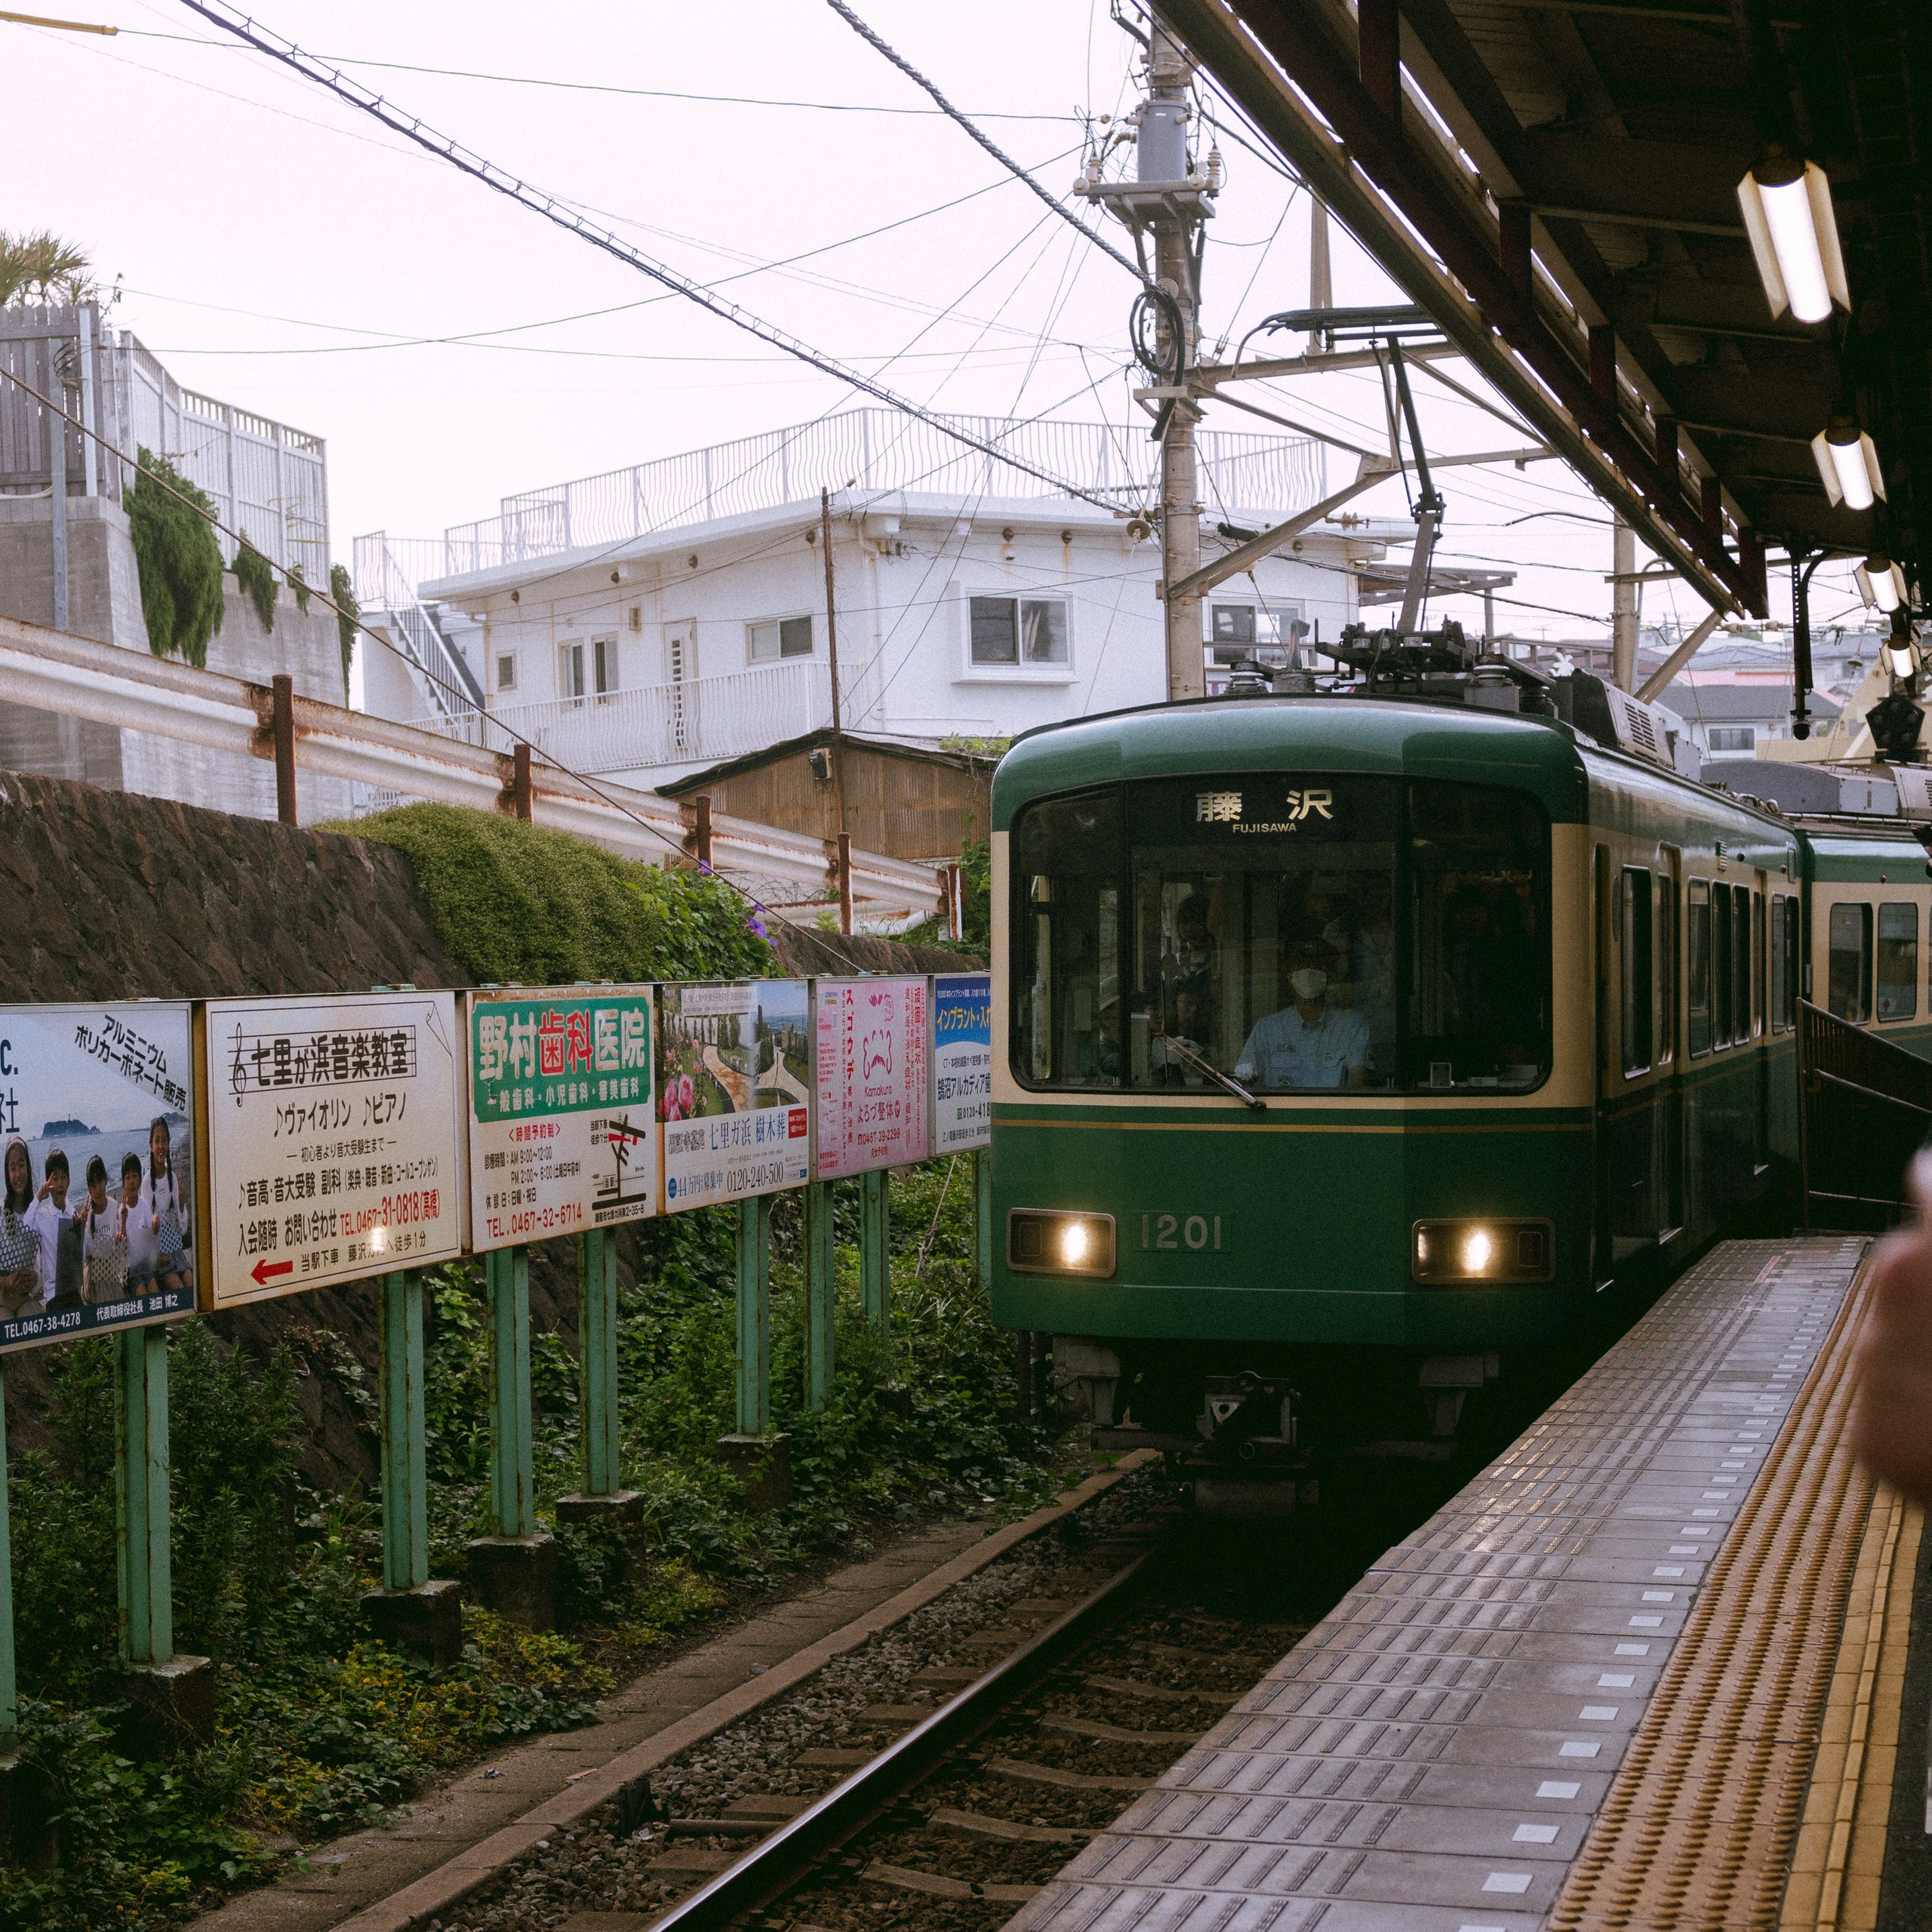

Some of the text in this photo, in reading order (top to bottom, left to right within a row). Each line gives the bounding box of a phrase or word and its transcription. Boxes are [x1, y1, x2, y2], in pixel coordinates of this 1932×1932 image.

[1196, 789, 1334, 822] 藤沢
[1233, 823, 1297, 834] FUJISAWA
[103, 1014, 167, 1075] アルミニウム
[251, 1029, 408, 1086] 七里が浜音楽教室
[478, 1007, 645, 1081] 野村歯科医院
[75, 1025, 187, 1112] ポリカーボネート販売
[487, 1076, 639, 1113] 一般歯科・小児歯科・審美歯科
[864, 1085, 892, 1097] Kamakura
[727, 1161, 783, 1193] 0120-240-500
[238, 1217, 278, 1257] 入会随時
[285, 1208, 337, 1247] お問い合わせ
[1142, 1214, 1221, 1250] 1201
[301, 1247, 340, 1272] 当駅下車
[5, 1312, 81, 1339] TEL.0467-38-4278
[97, 1300, 144, 1321] 代表取締役社長
